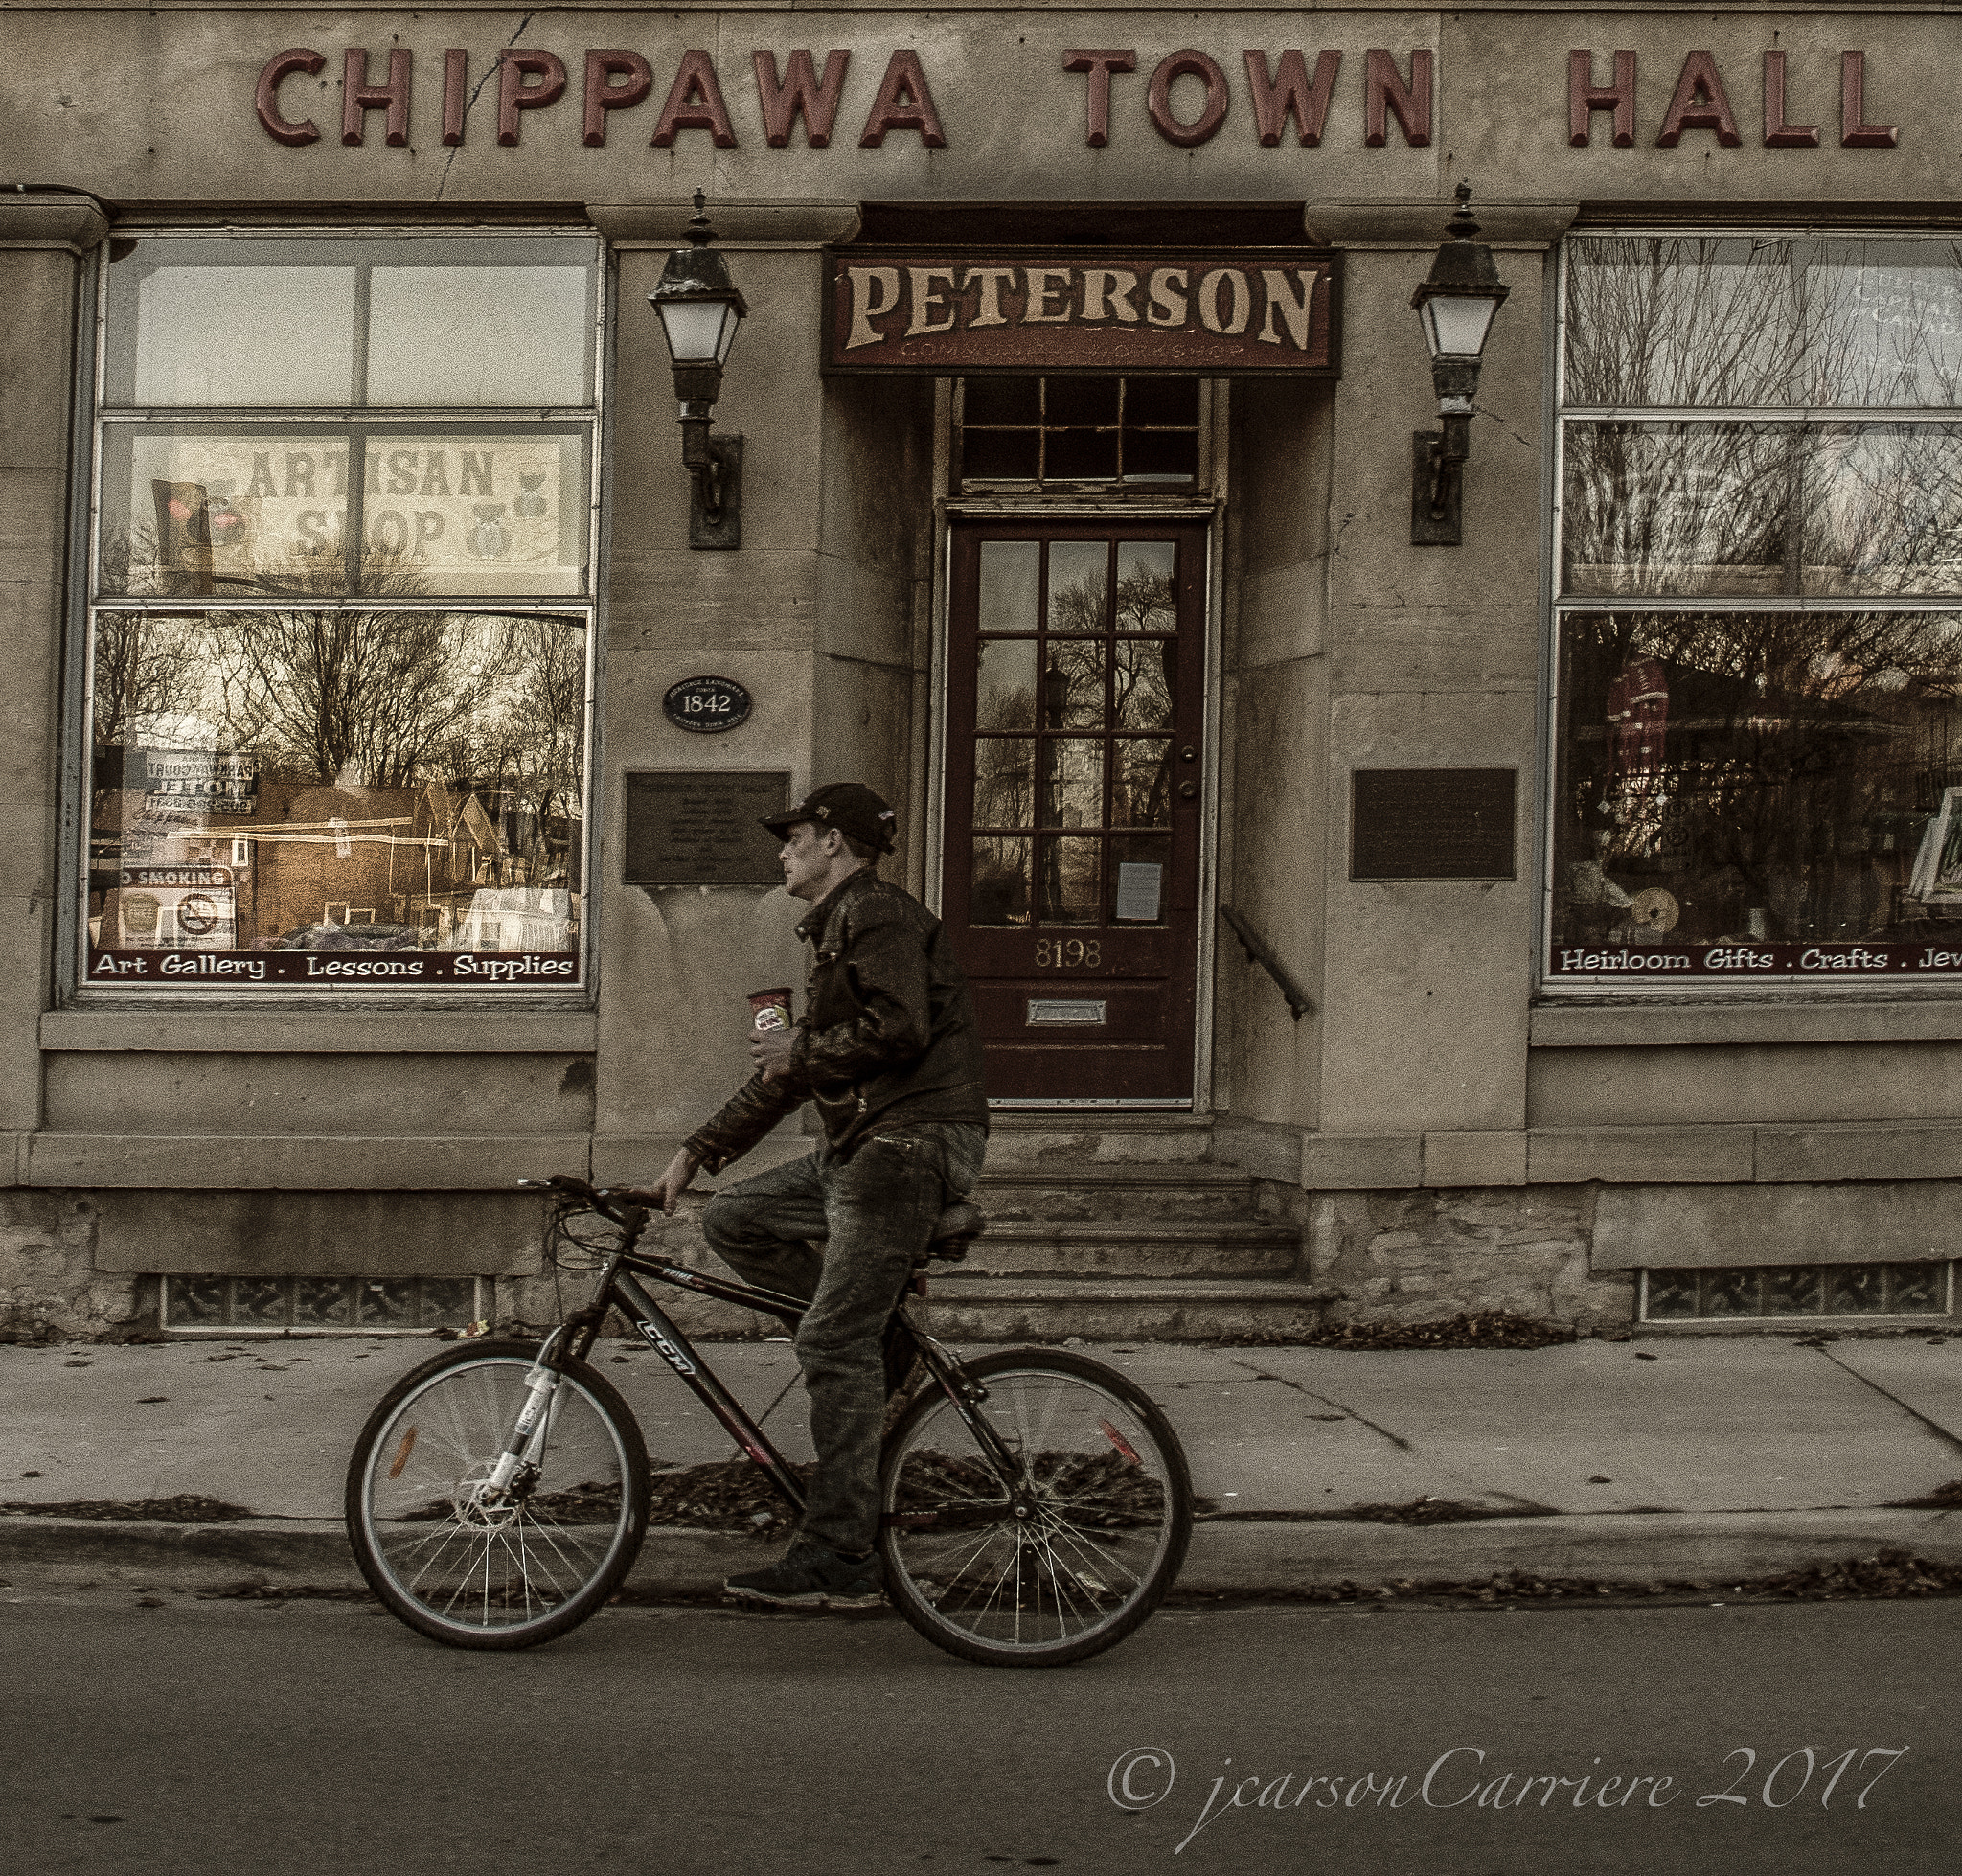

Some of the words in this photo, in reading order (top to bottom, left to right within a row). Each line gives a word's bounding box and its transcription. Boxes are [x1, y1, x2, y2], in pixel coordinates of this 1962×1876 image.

[255, 47, 948, 149] CHIPPAWA
[1061, 47, 1434, 149] TOWN
[1567, 48, 1900, 149] HALL
[846, 265, 1319, 351] PETERSON
[246, 449, 495, 498] ARTISAN
[683, 694, 731, 713] 1842
[138, 871, 225, 885] SMOKING
[91, 954, 148, 975] Art
[159, 954, 266, 979] Gallery
[307, 955, 424, 976] Lessons
[453, 954, 574, 981] Supplies
[1036, 938, 1102, 969] 8198
[1560, 948, 1692, 971] Heirloom
[1703, 947, 1775, 970] Gifts
[1799, 947, 1889, 970] Crafts
[643, 1323, 690, 1371] CCM
